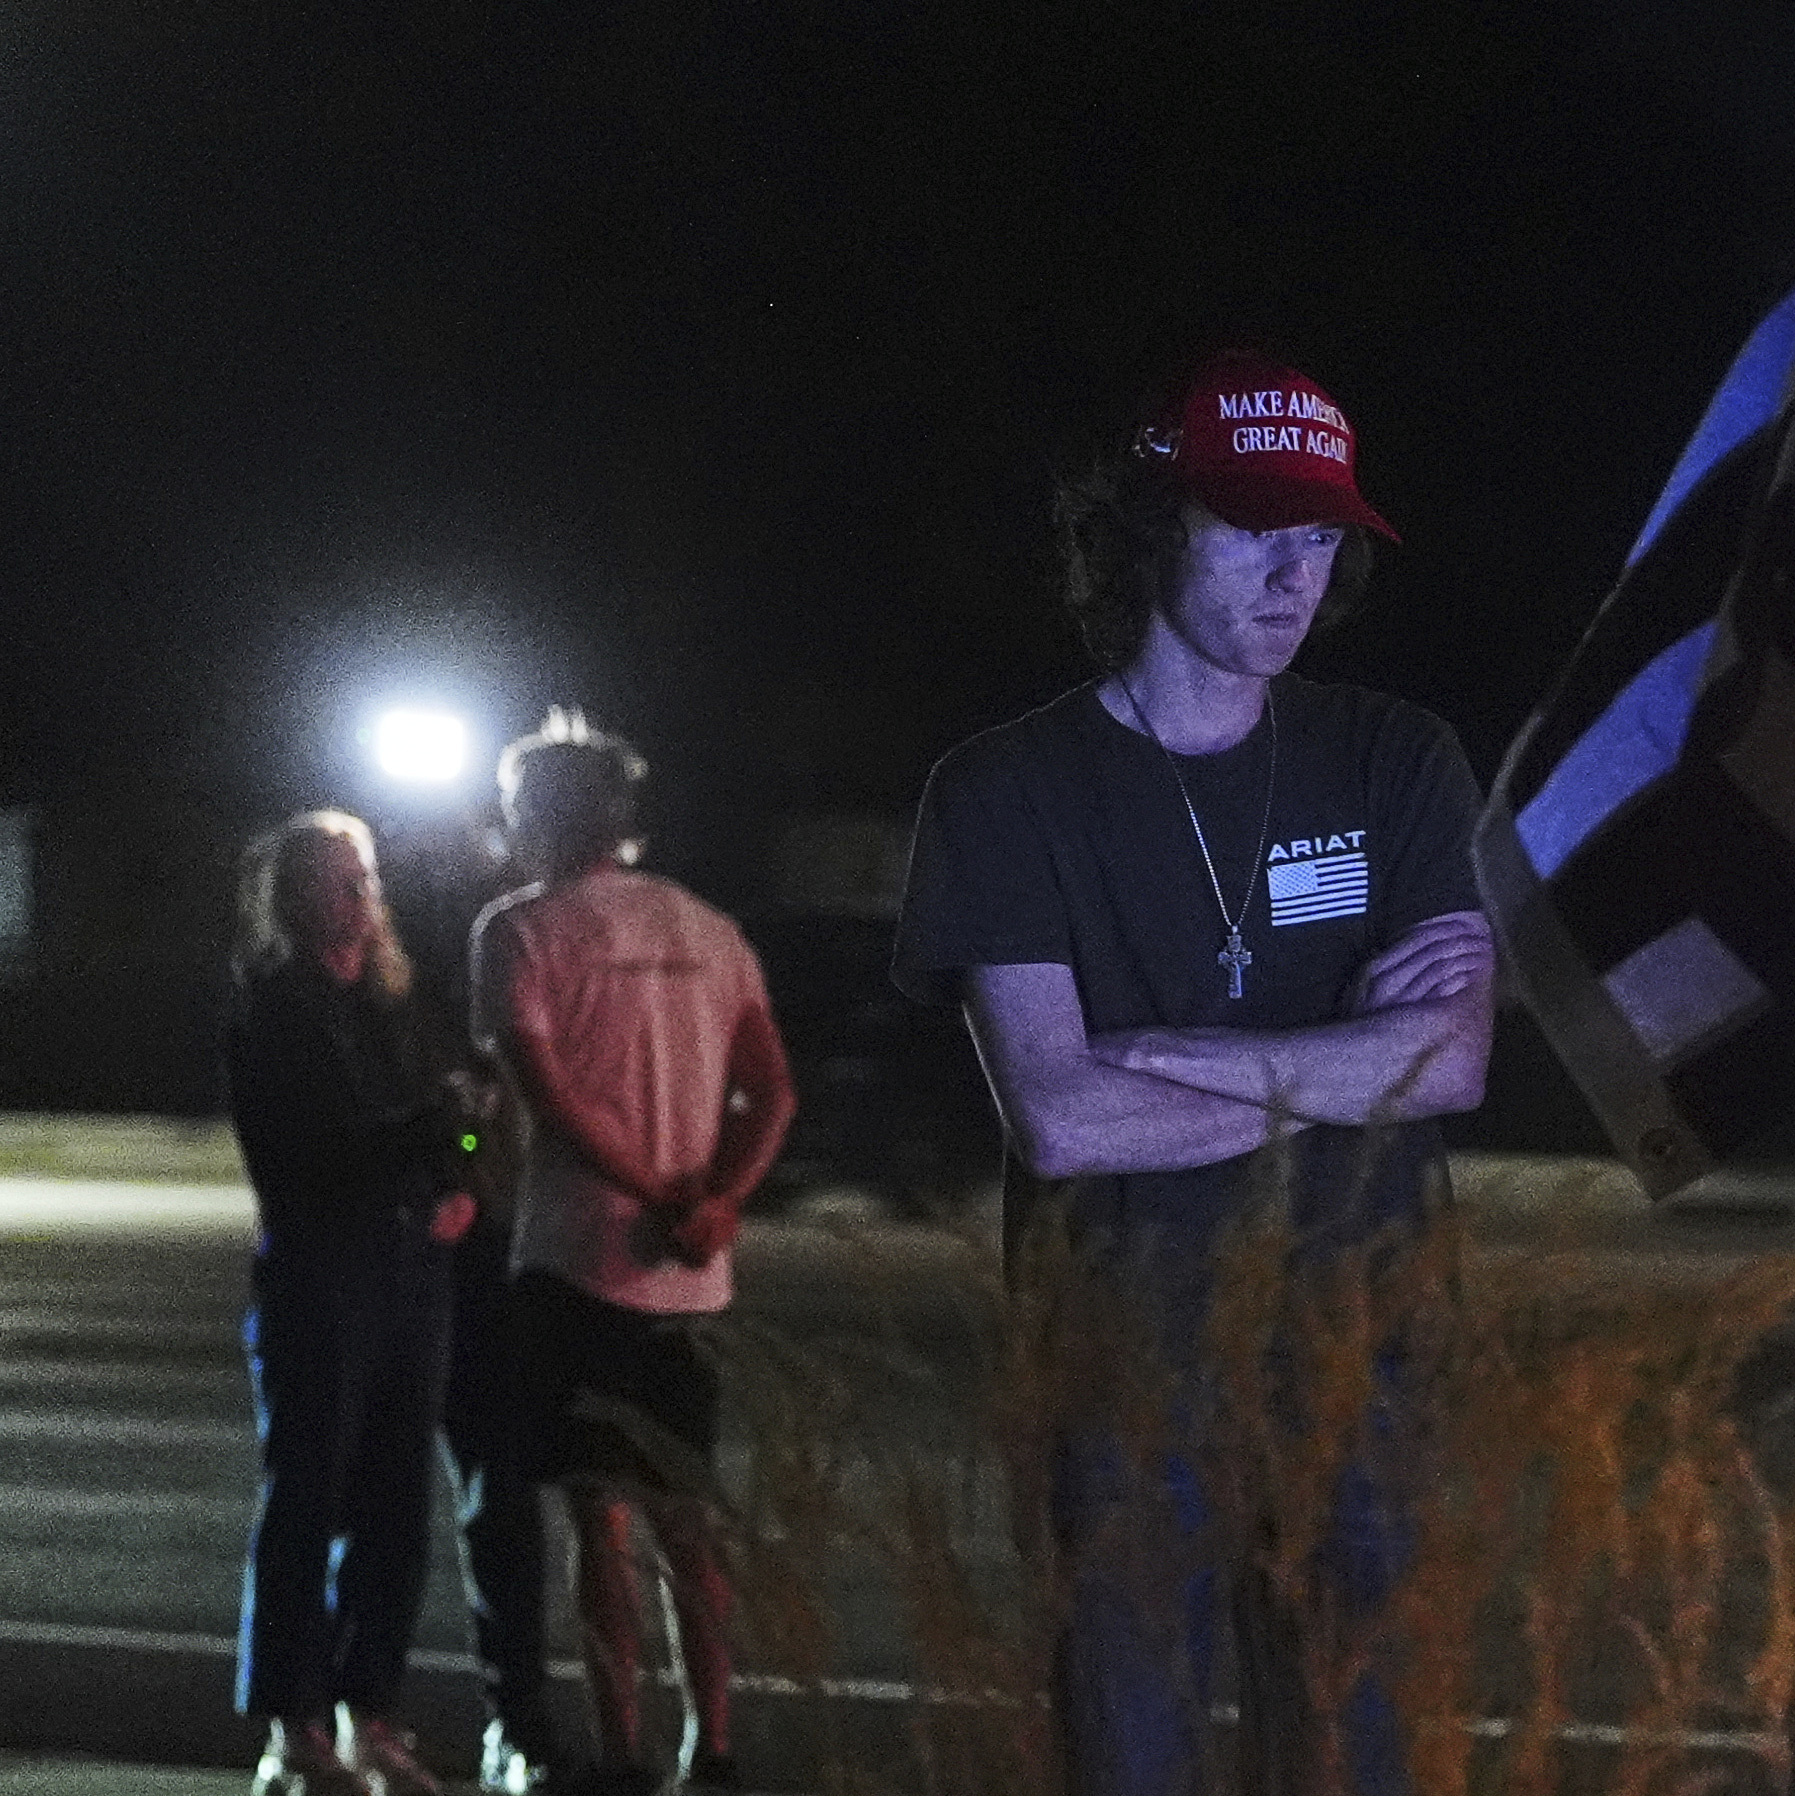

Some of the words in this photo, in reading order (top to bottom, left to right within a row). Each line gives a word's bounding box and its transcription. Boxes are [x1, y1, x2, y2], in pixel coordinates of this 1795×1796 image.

[1219, 390, 1284, 419] MAKE
[1233, 426, 1302, 454] GREAT
[1267, 830, 1366, 862] ARIAT
